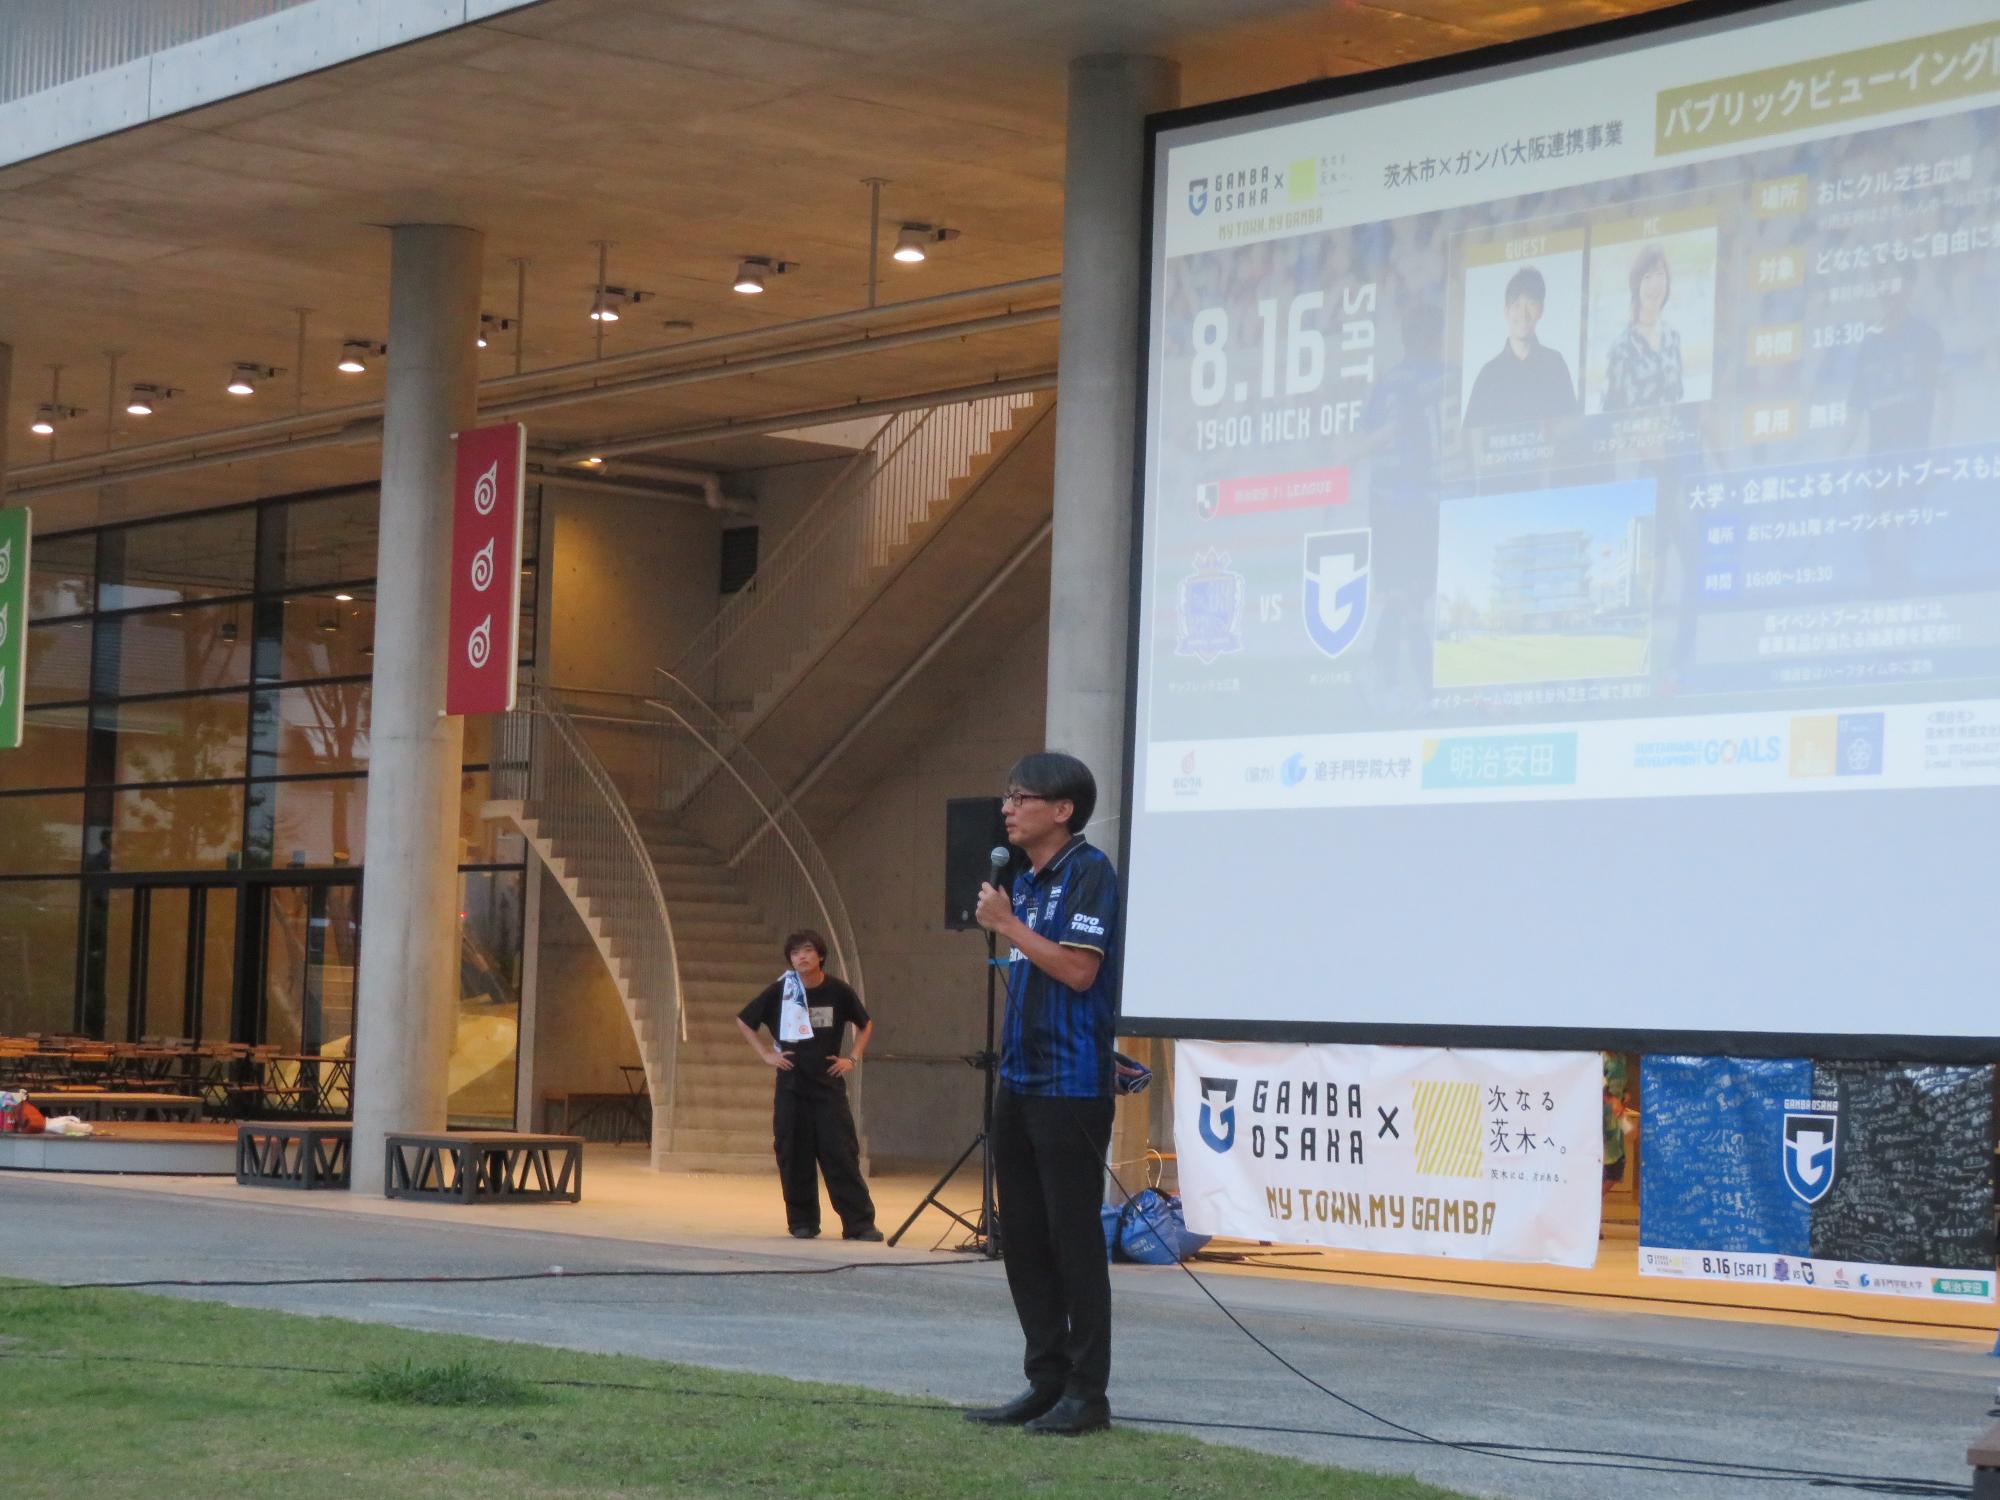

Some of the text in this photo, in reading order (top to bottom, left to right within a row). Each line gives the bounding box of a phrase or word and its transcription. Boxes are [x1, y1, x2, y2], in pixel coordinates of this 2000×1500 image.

[1664, 35, 2000, 138] パブリックビューイング
[1214, 165, 1269, 193] GAMBA
[1816, 154, 1973, 205] おにクル芝生広場
[1213, 187, 1268, 214] OSAKA
[1505, 236, 1547, 259] GUEST
[1190, 290, 1326, 408] 8.16
[1340, 283, 1377, 383] SAT
[1198, 400, 1363, 451] 19:00 KICK OFF
[1260, 594, 1282, 622] VS
[1450, 743, 1554, 780] 明治安田
[1704, 735, 1782, 765] GOALS
[1314, 757, 1412, 783] 追手門学院大学
[1071, 921, 1105, 936] TIRES
[1252, 1080, 1362, 1119] GAMBA
[1487, 1084, 1555, 1112] 次なる
[1252, 1125, 1364, 1165] OSAKA
[1265, 1186, 1292, 1221] MY
[1411, 1196, 1497, 1236] GAMBA
[1703, 1257, 1731, 1275] 8.16
